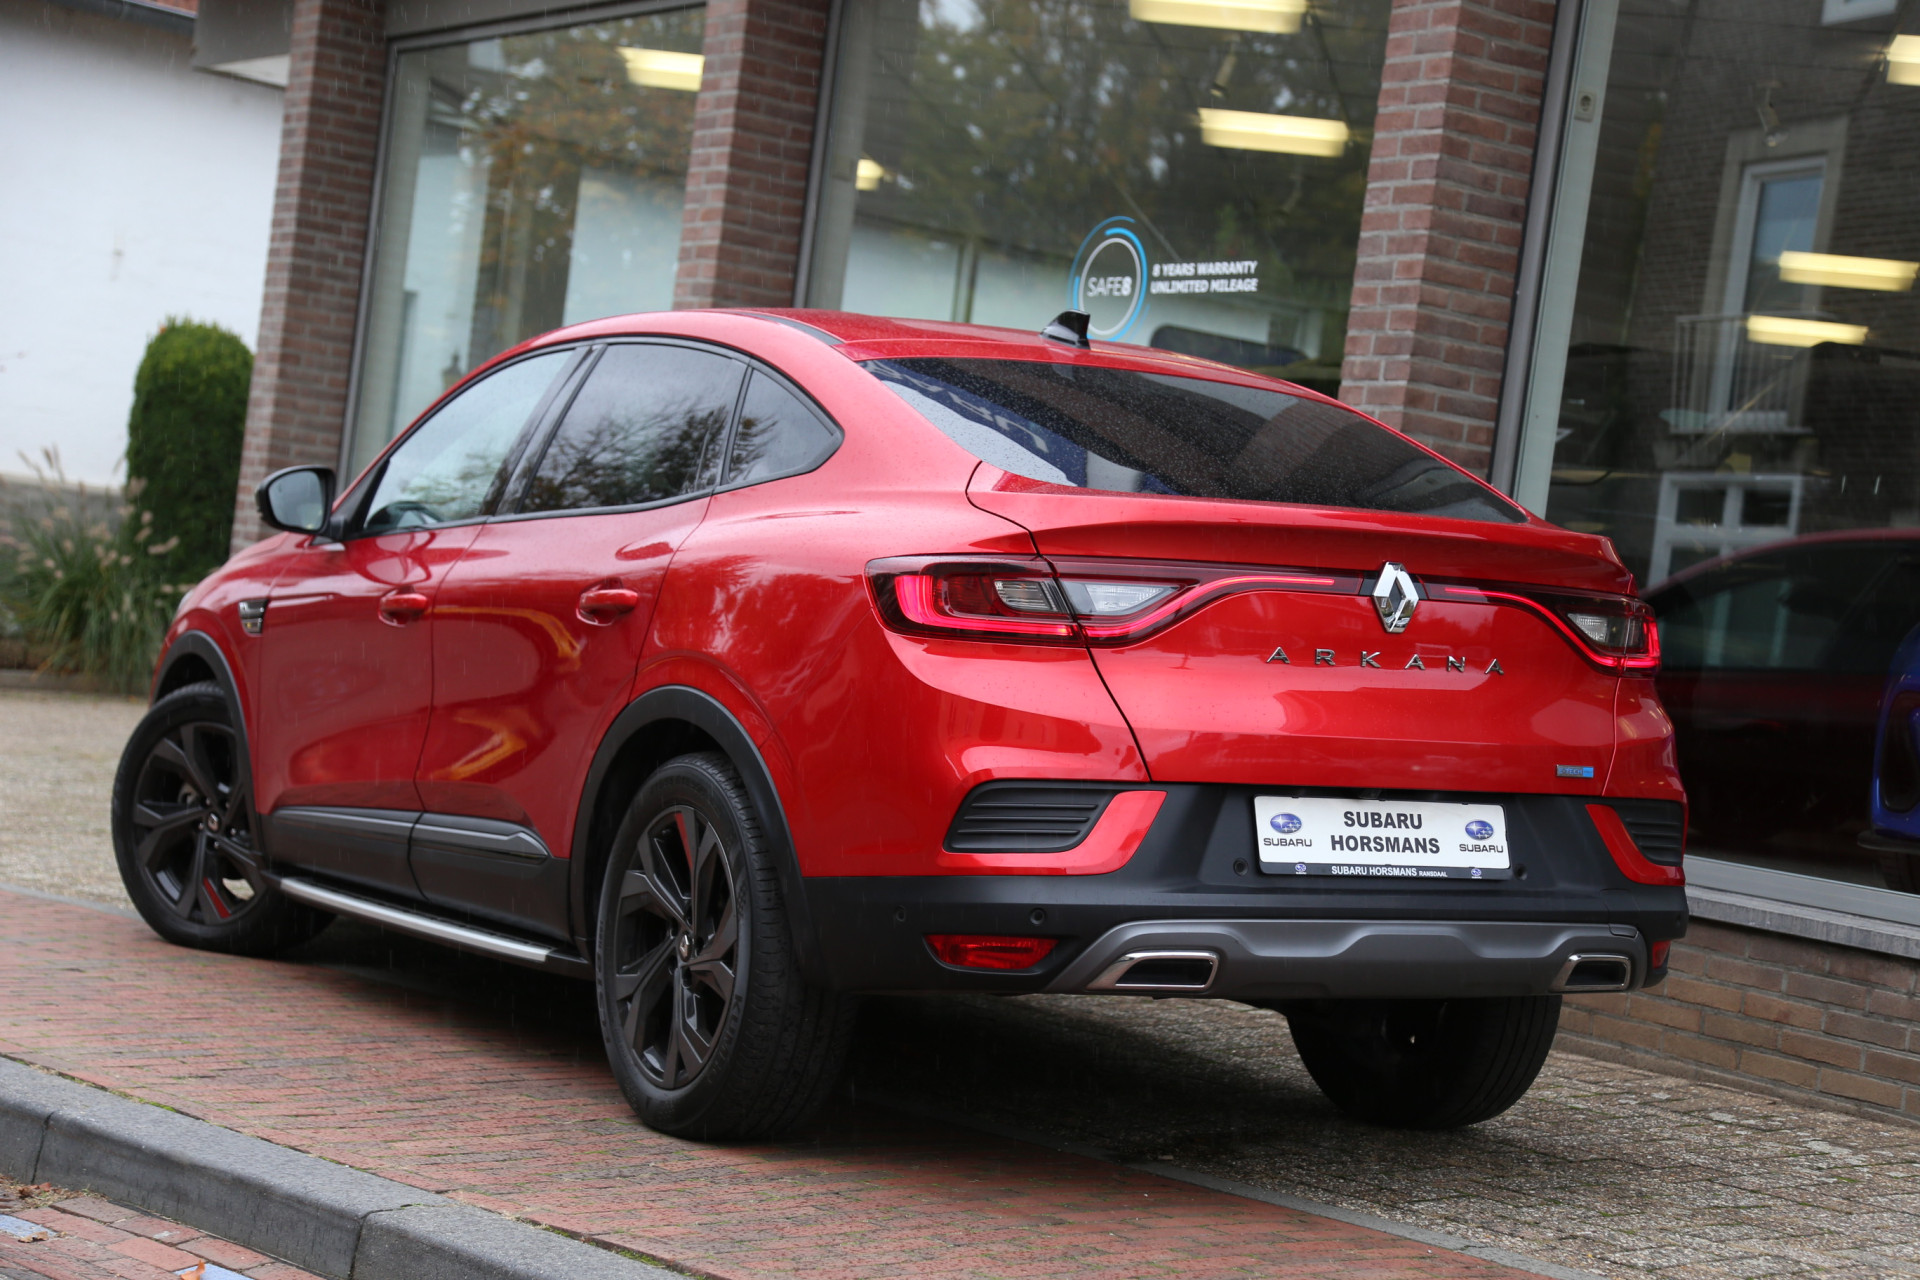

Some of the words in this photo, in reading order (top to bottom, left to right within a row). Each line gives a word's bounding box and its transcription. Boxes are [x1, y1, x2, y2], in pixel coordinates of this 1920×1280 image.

[1152, 263, 1161, 277] 8
[1162, 262, 1195, 277] YEARS
[1196, 260, 1258, 276] WARRANTY
[1087, 276, 1132, 297] SAFE8
[1150, 279, 1209, 295] UNLIMITED
[1209, 277, 1259, 293] MILEAGE
[1266, 646, 1505, 675] ARKANA
[1343, 810, 1423, 830] SUBARU
[1263, 837, 1313, 848] SUBARU
[1330, 834, 1441, 854] HORSMANS
[1459, 843, 1504, 854] SUBARU
[1331, 865, 1368, 876] SUBARU
[1369, 866, 1418, 877] HORSMANS
[1418, 870, 1448, 878] RANSDAAL
